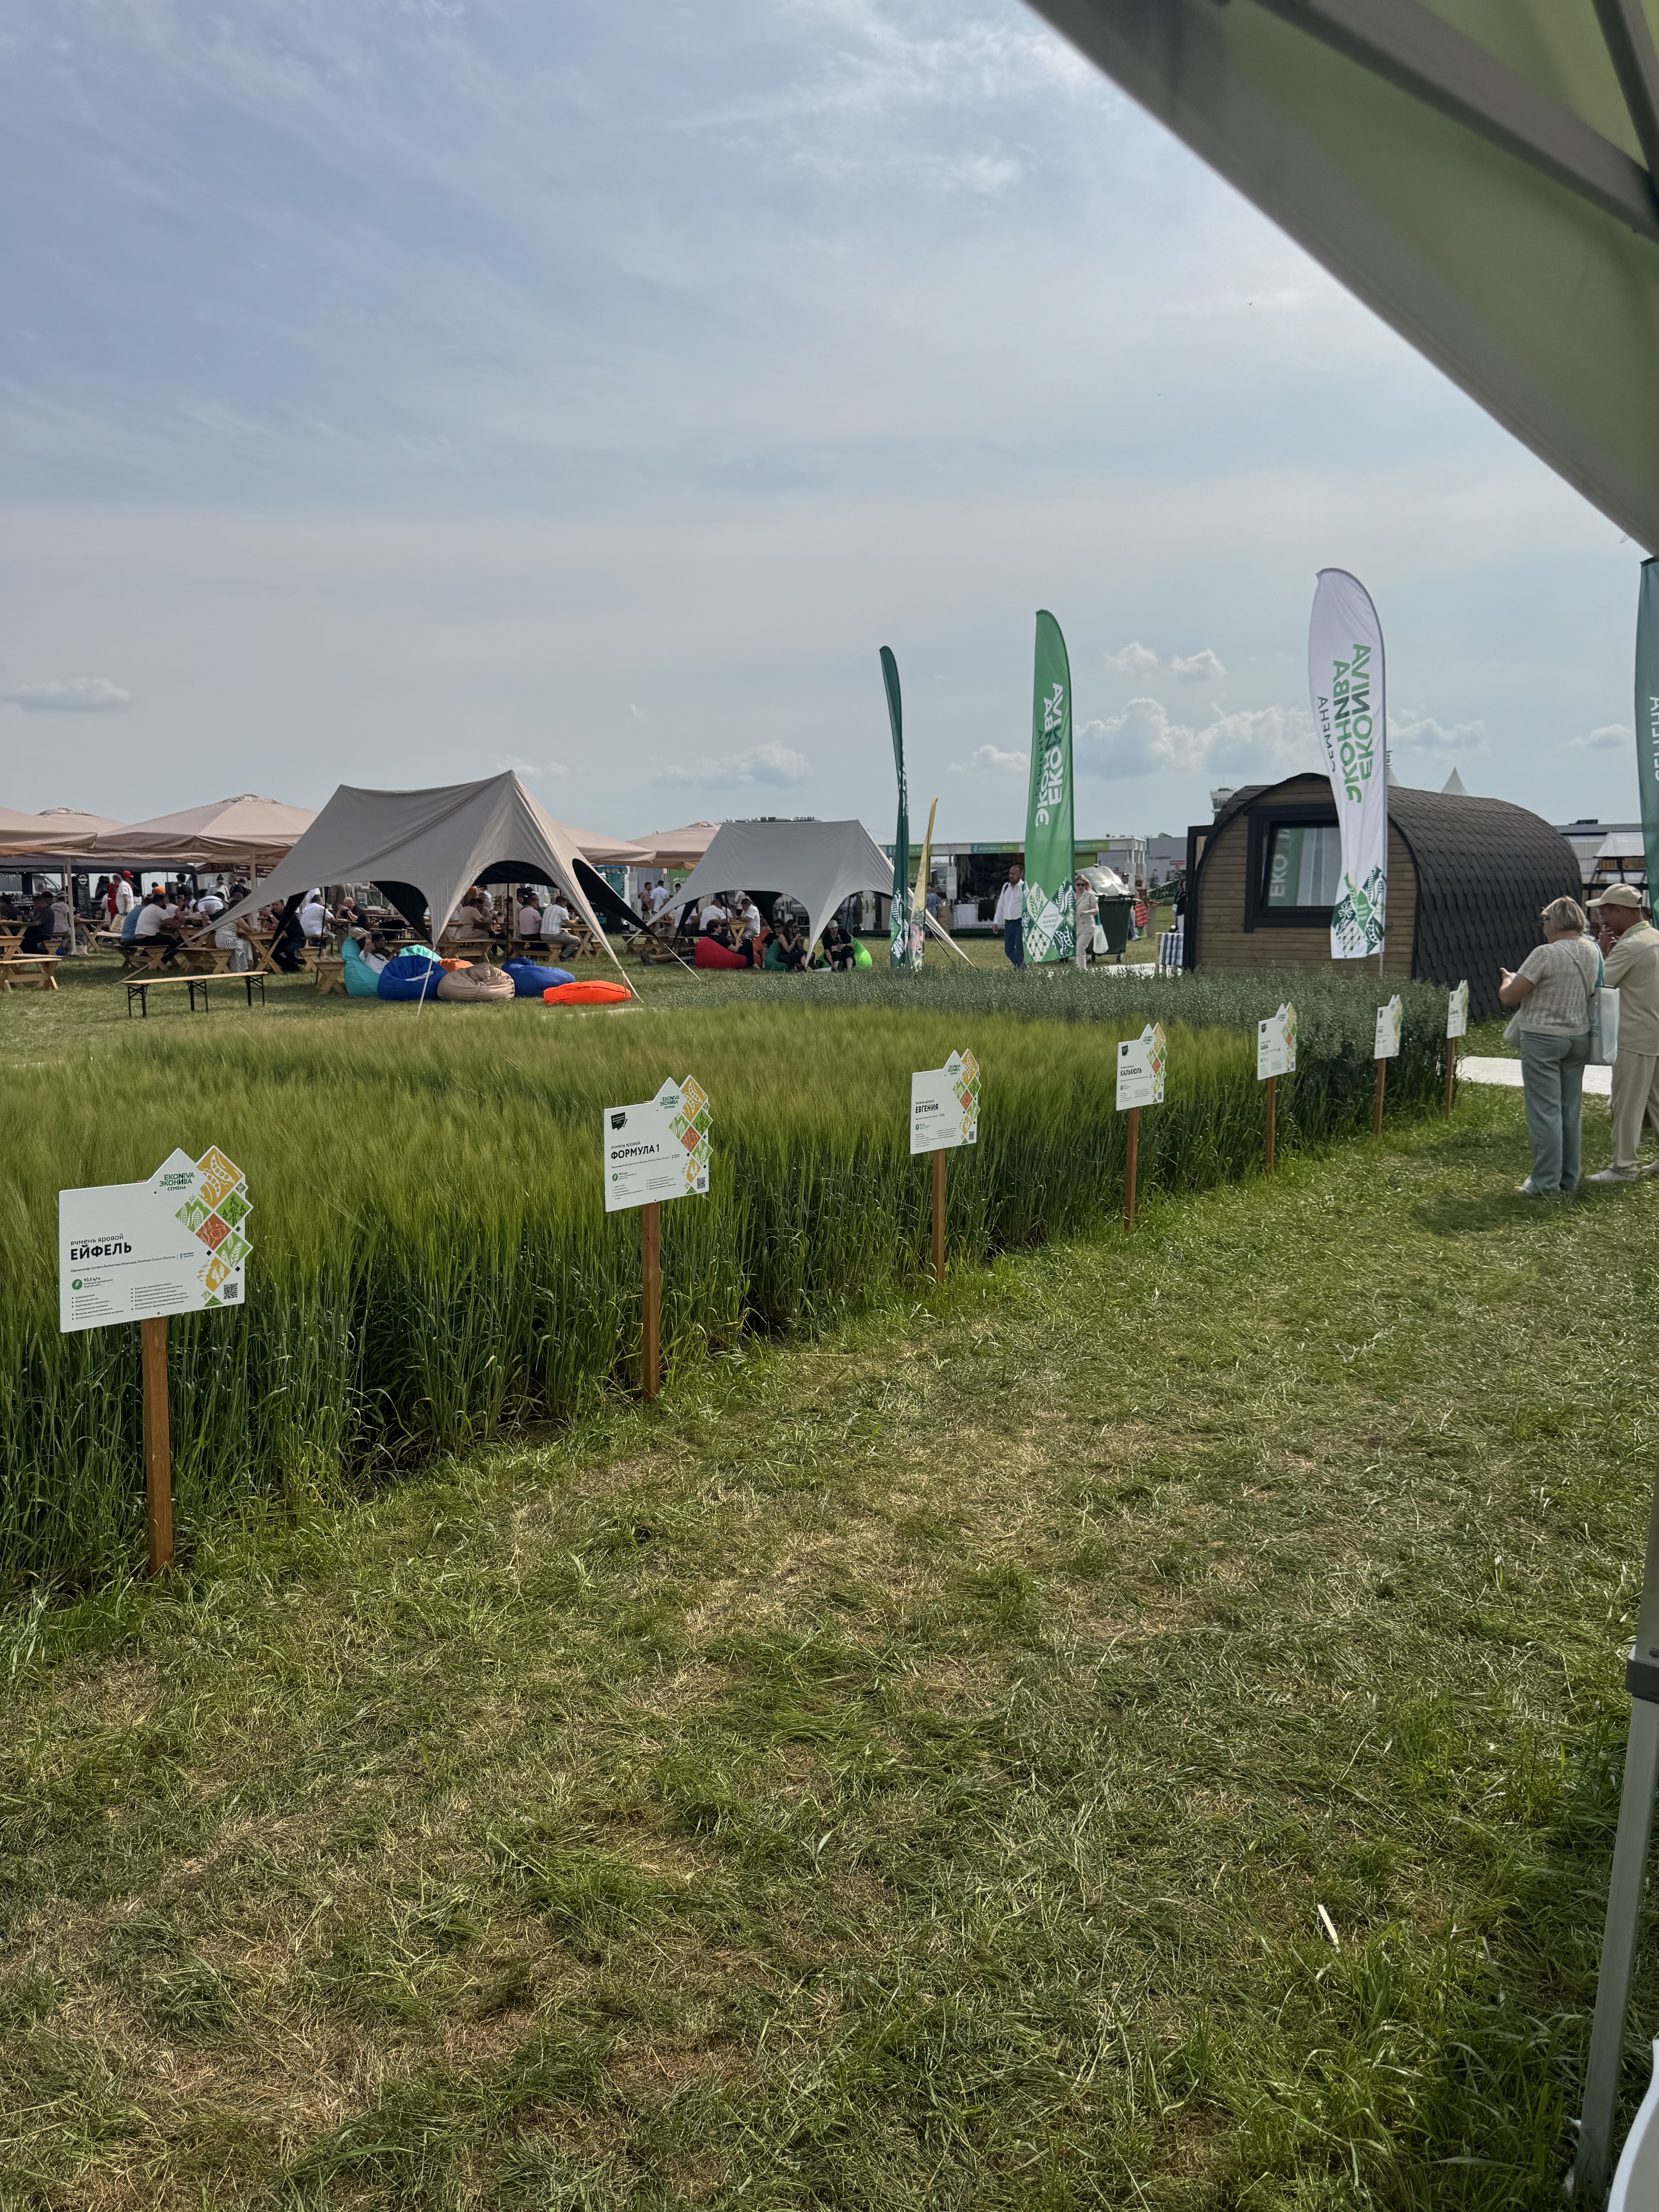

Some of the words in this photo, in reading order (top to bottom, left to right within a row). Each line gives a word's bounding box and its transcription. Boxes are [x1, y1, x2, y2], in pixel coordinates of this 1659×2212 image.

[915, 1103, 938, 1113] ЕВГЕНИЯ
[611, 1145, 655, 1159] ФОРМУЛА
[656, 1144, 659, 1152] 1
[164, 1172, 195, 1180] EKONIVA
[159, 1178, 192, 1187] ЭКОНИВА
[98, 1233, 124, 1243] яровой
[71, 1242, 132, 1261] ЕЙФЕЛЬ
